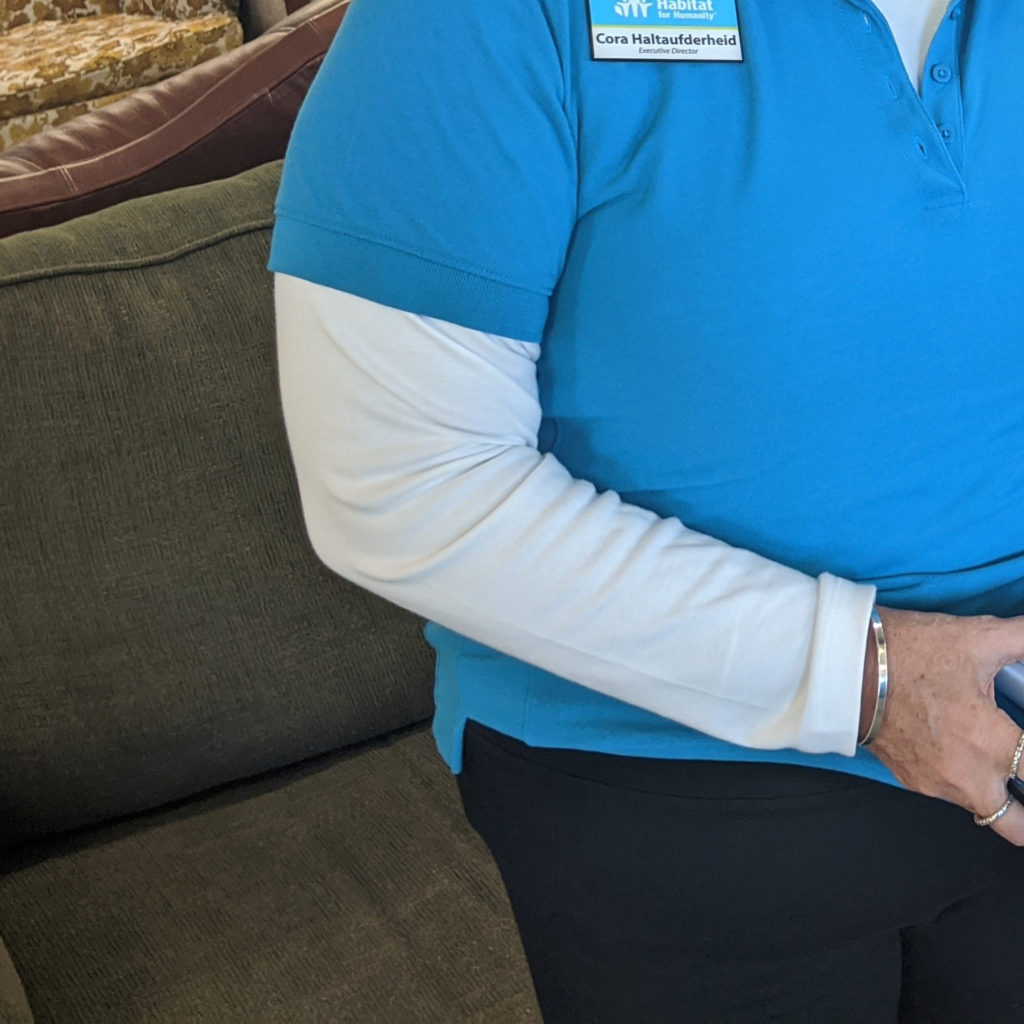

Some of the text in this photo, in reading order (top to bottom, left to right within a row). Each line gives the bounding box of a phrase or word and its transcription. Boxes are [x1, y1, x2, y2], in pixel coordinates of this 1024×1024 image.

[658, 11, 714, 21] for Humanity
[596, 33, 737, 46] Cora Haltaufderheid
